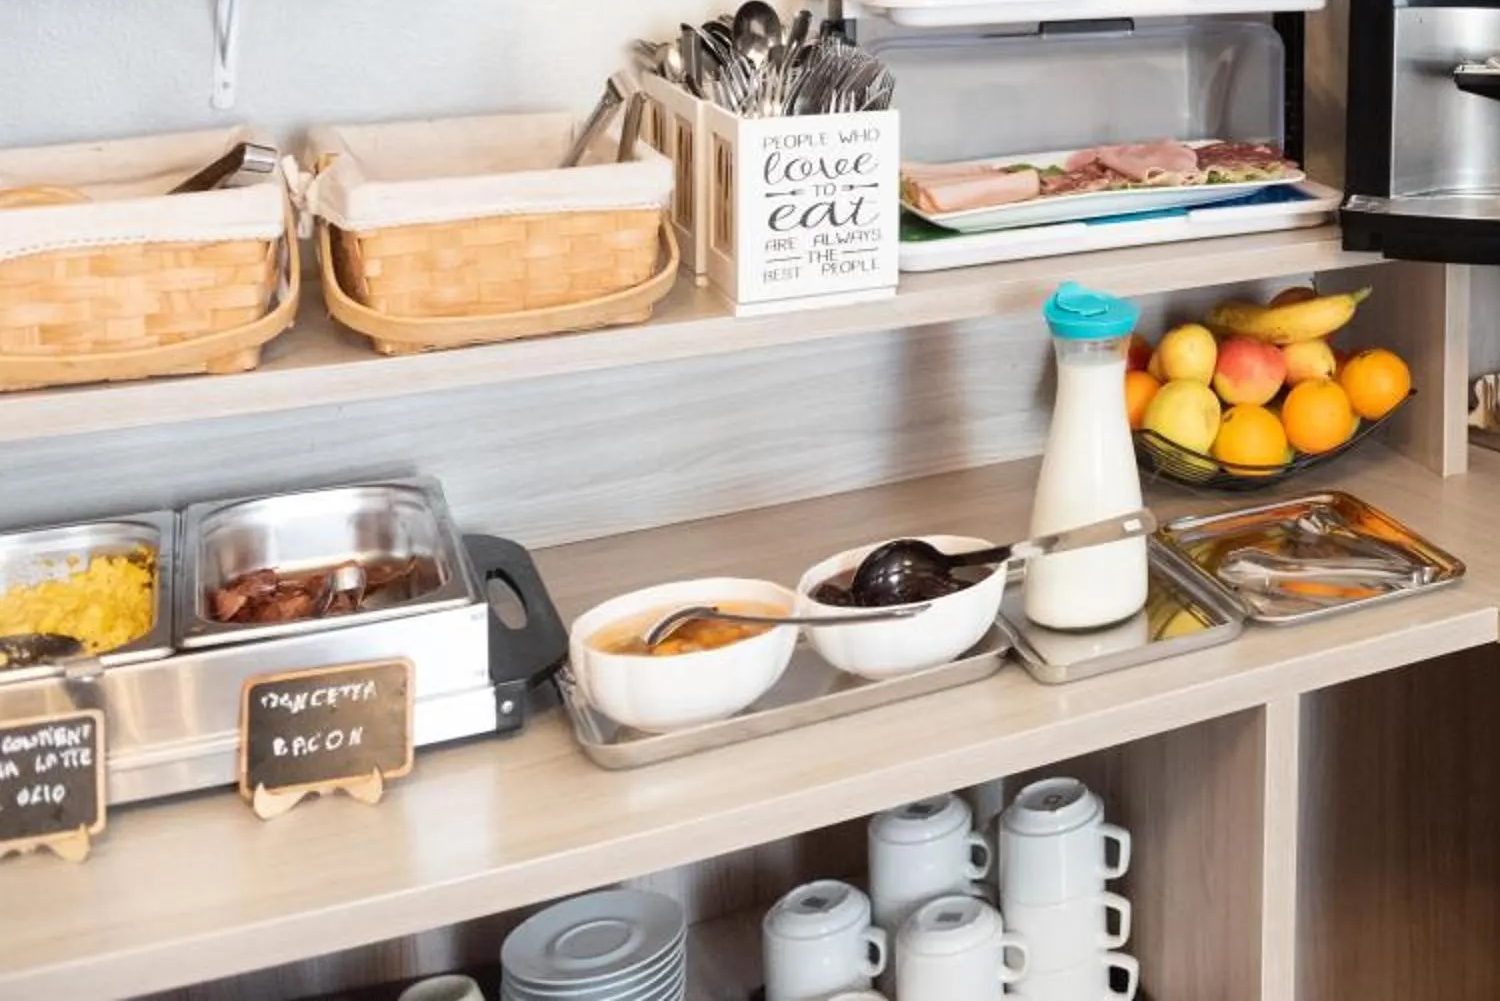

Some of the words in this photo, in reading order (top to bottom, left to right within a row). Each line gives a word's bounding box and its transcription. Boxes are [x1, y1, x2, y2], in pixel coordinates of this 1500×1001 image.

[763, 132, 829, 150] PEOPLE
[838, 127, 881, 145] WHO
[813, 183, 837, 198] TO
[768, 196, 881, 232] eat
[765, 237, 797, 252] ARE
[813, 228, 882, 248] ALWAYS
[808, 249, 839, 264] THE
[763, 266, 802, 285] BEST
[821, 259, 881, 276] PEOPLE
[272, 725, 364, 757] BACON
[35, 747, 93, 775] LATTE
[16, 783, 66, 807] OLIO
